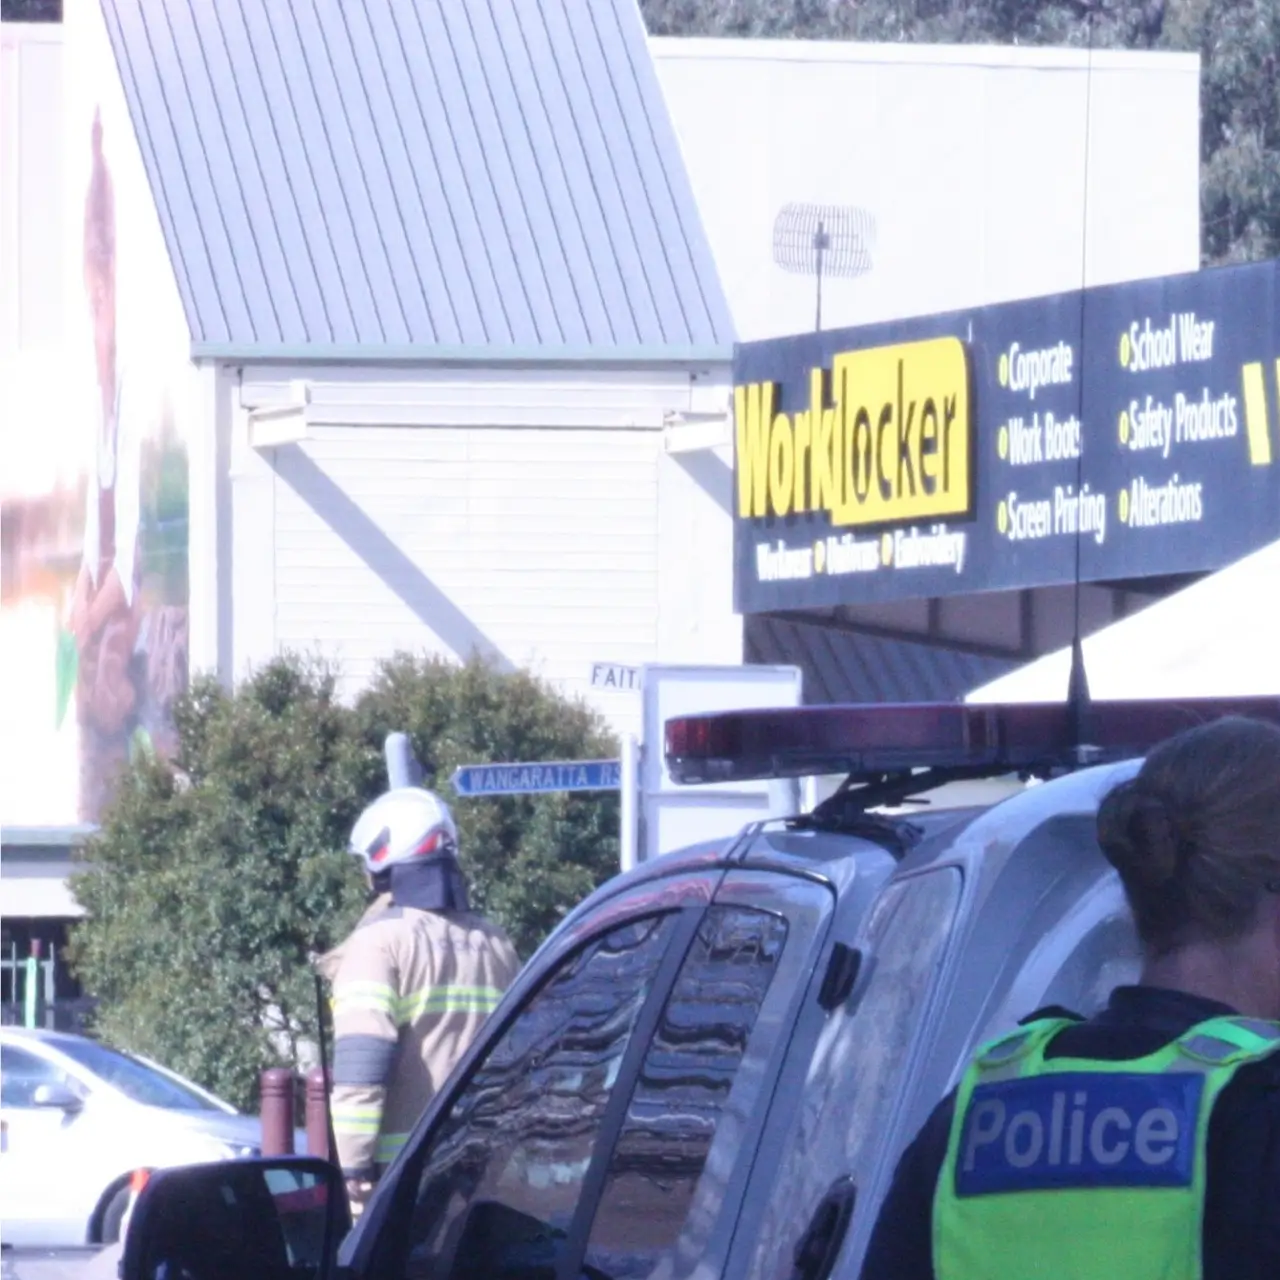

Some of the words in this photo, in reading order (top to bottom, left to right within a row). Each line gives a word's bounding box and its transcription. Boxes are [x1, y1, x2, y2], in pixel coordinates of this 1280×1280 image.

[1009, 341, 1072, 399] Corporate
[1130, 313, 1176, 372] School
[1179, 312, 1214, 361] Wear
[1008, 413, 1042, 465] Work
[1046, 412, 1083, 460] Boots
[1129, 395, 1172, 458] Safety
[1175, 387, 1237, 442] Products
[1008, 492, 1051, 540] Screen
[1055, 483, 1106, 544] Printing
[1129, 473, 1202, 527] Alterations
[469, 766, 588, 790] WANGARATTA
[963, 1092, 1178, 1174] Police
